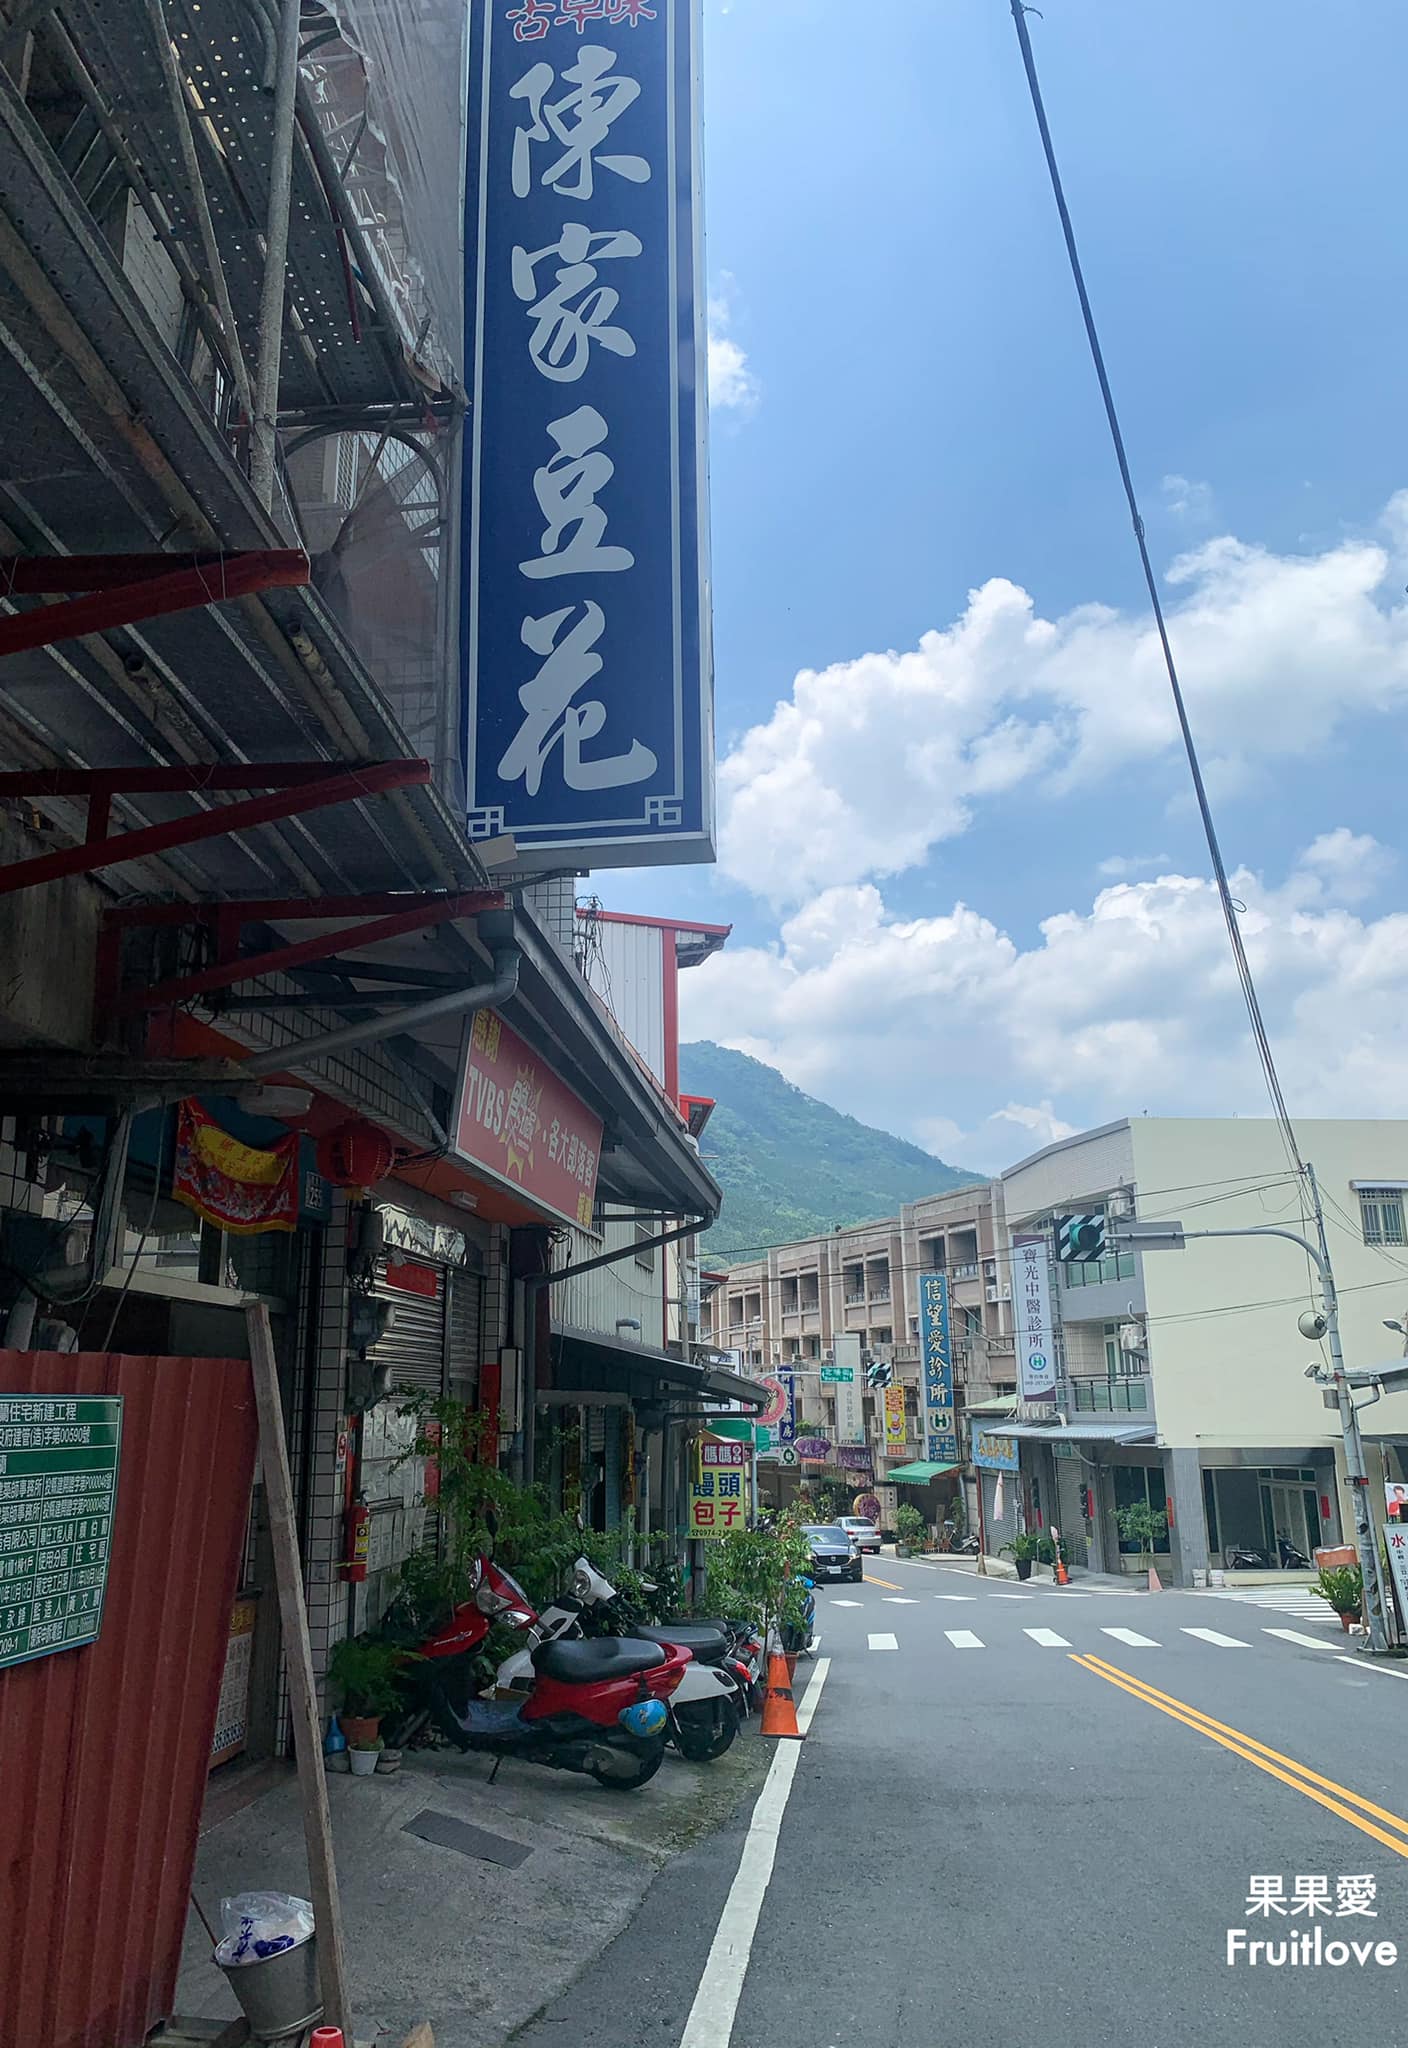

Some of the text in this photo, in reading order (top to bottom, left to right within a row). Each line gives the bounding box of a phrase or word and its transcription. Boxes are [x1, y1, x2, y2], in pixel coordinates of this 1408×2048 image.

[497, 45, 659, 798] 陳家豆花
[466, 1064, 505, 1137] TVBS
[1023, 1248, 1044, 1350] 寶光中醫診所
[925, 1280, 949, 1405] 信望愛診所
[704, 1444, 732, 1464] 媽媽
[0, 1478, 42, 1500] 築師事務所
[693, 1472, 741, 1497] 饅頭
[0, 1502, 41, 1524] 築師事務所
[693, 1500, 741, 1527] 包子
